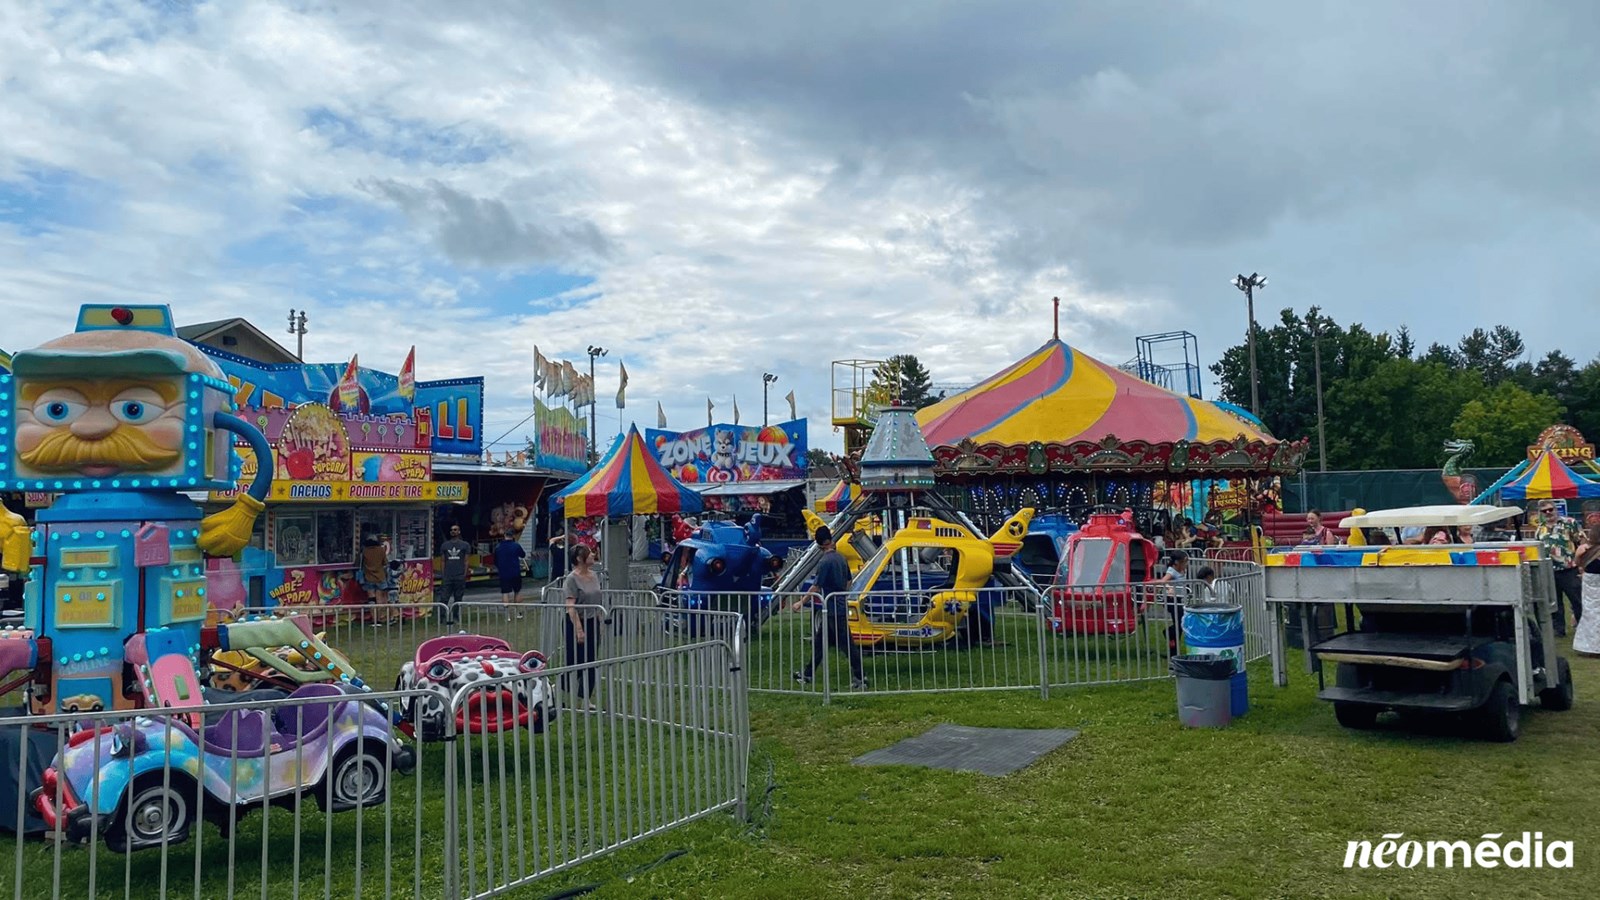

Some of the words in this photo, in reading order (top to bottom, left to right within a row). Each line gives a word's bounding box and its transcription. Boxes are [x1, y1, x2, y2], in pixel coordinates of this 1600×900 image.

[658, 435, 711, 466] ZONE
[737, 440, 795, 467] JEUX
[1530, 447, 1592, 459] VKING
[312, 460, 346, 474] POPCORN
[290, 484, 332, 498] NACHOS
[349, 485, 387, 498] POMME
[389, 485, 401, 497] DE
[403, 485, 422, 498] TIRE
[436, 485, 462, 497] SLUSH
